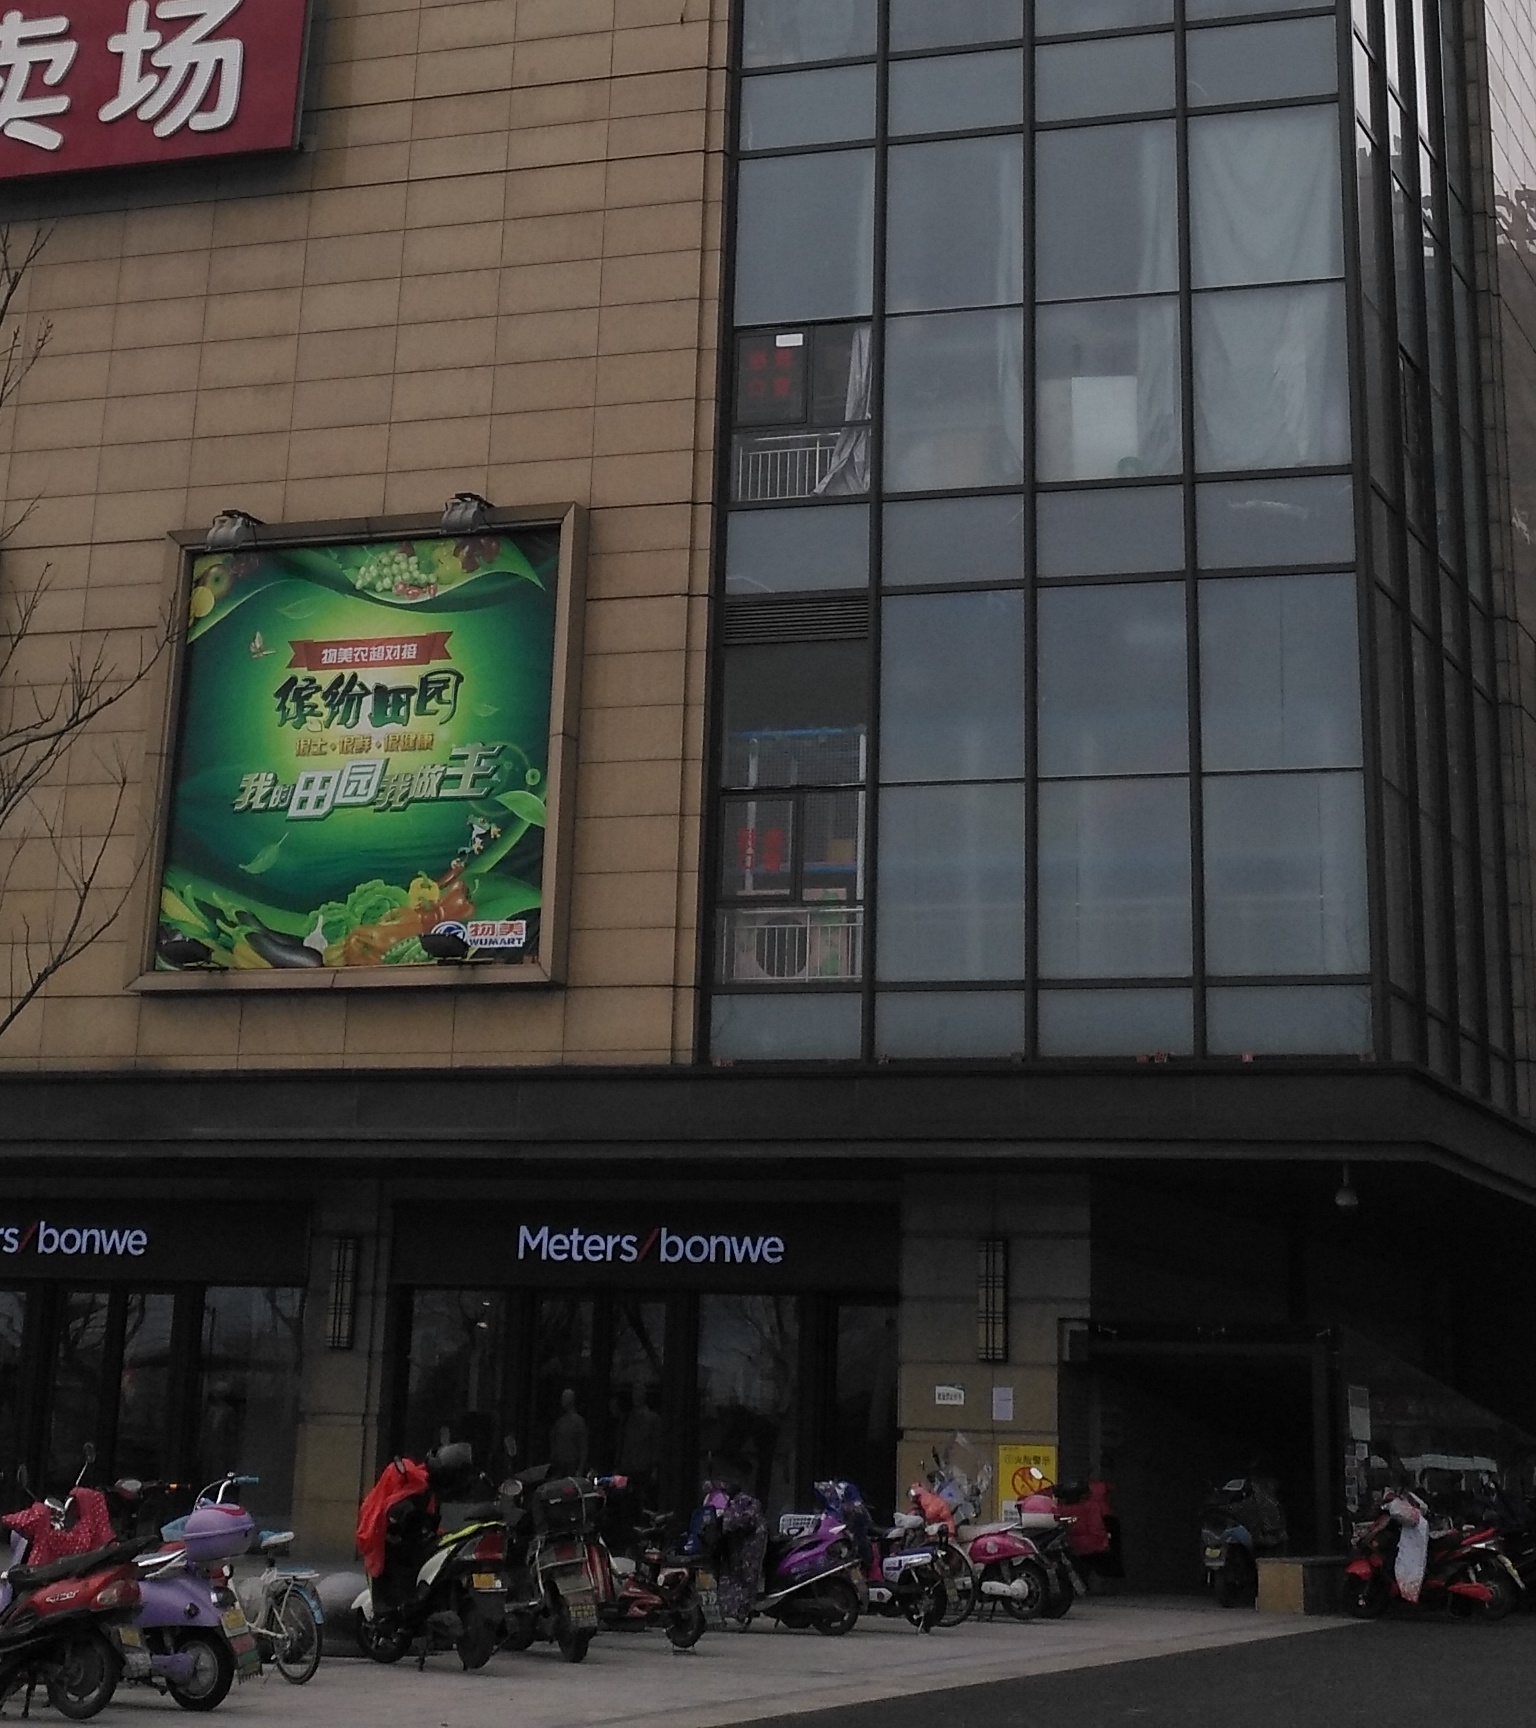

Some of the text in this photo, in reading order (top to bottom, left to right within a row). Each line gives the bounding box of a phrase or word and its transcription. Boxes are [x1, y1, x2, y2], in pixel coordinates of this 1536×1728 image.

[321, 642, 419, 665] 物美农超对接
[272, 667, 466, 730] 缤纷田园
[232, 743, 508, 822] 我的田园我做主
[469, 923, 524, 937] 物美
[469, 937, 524, 947] WUMART
